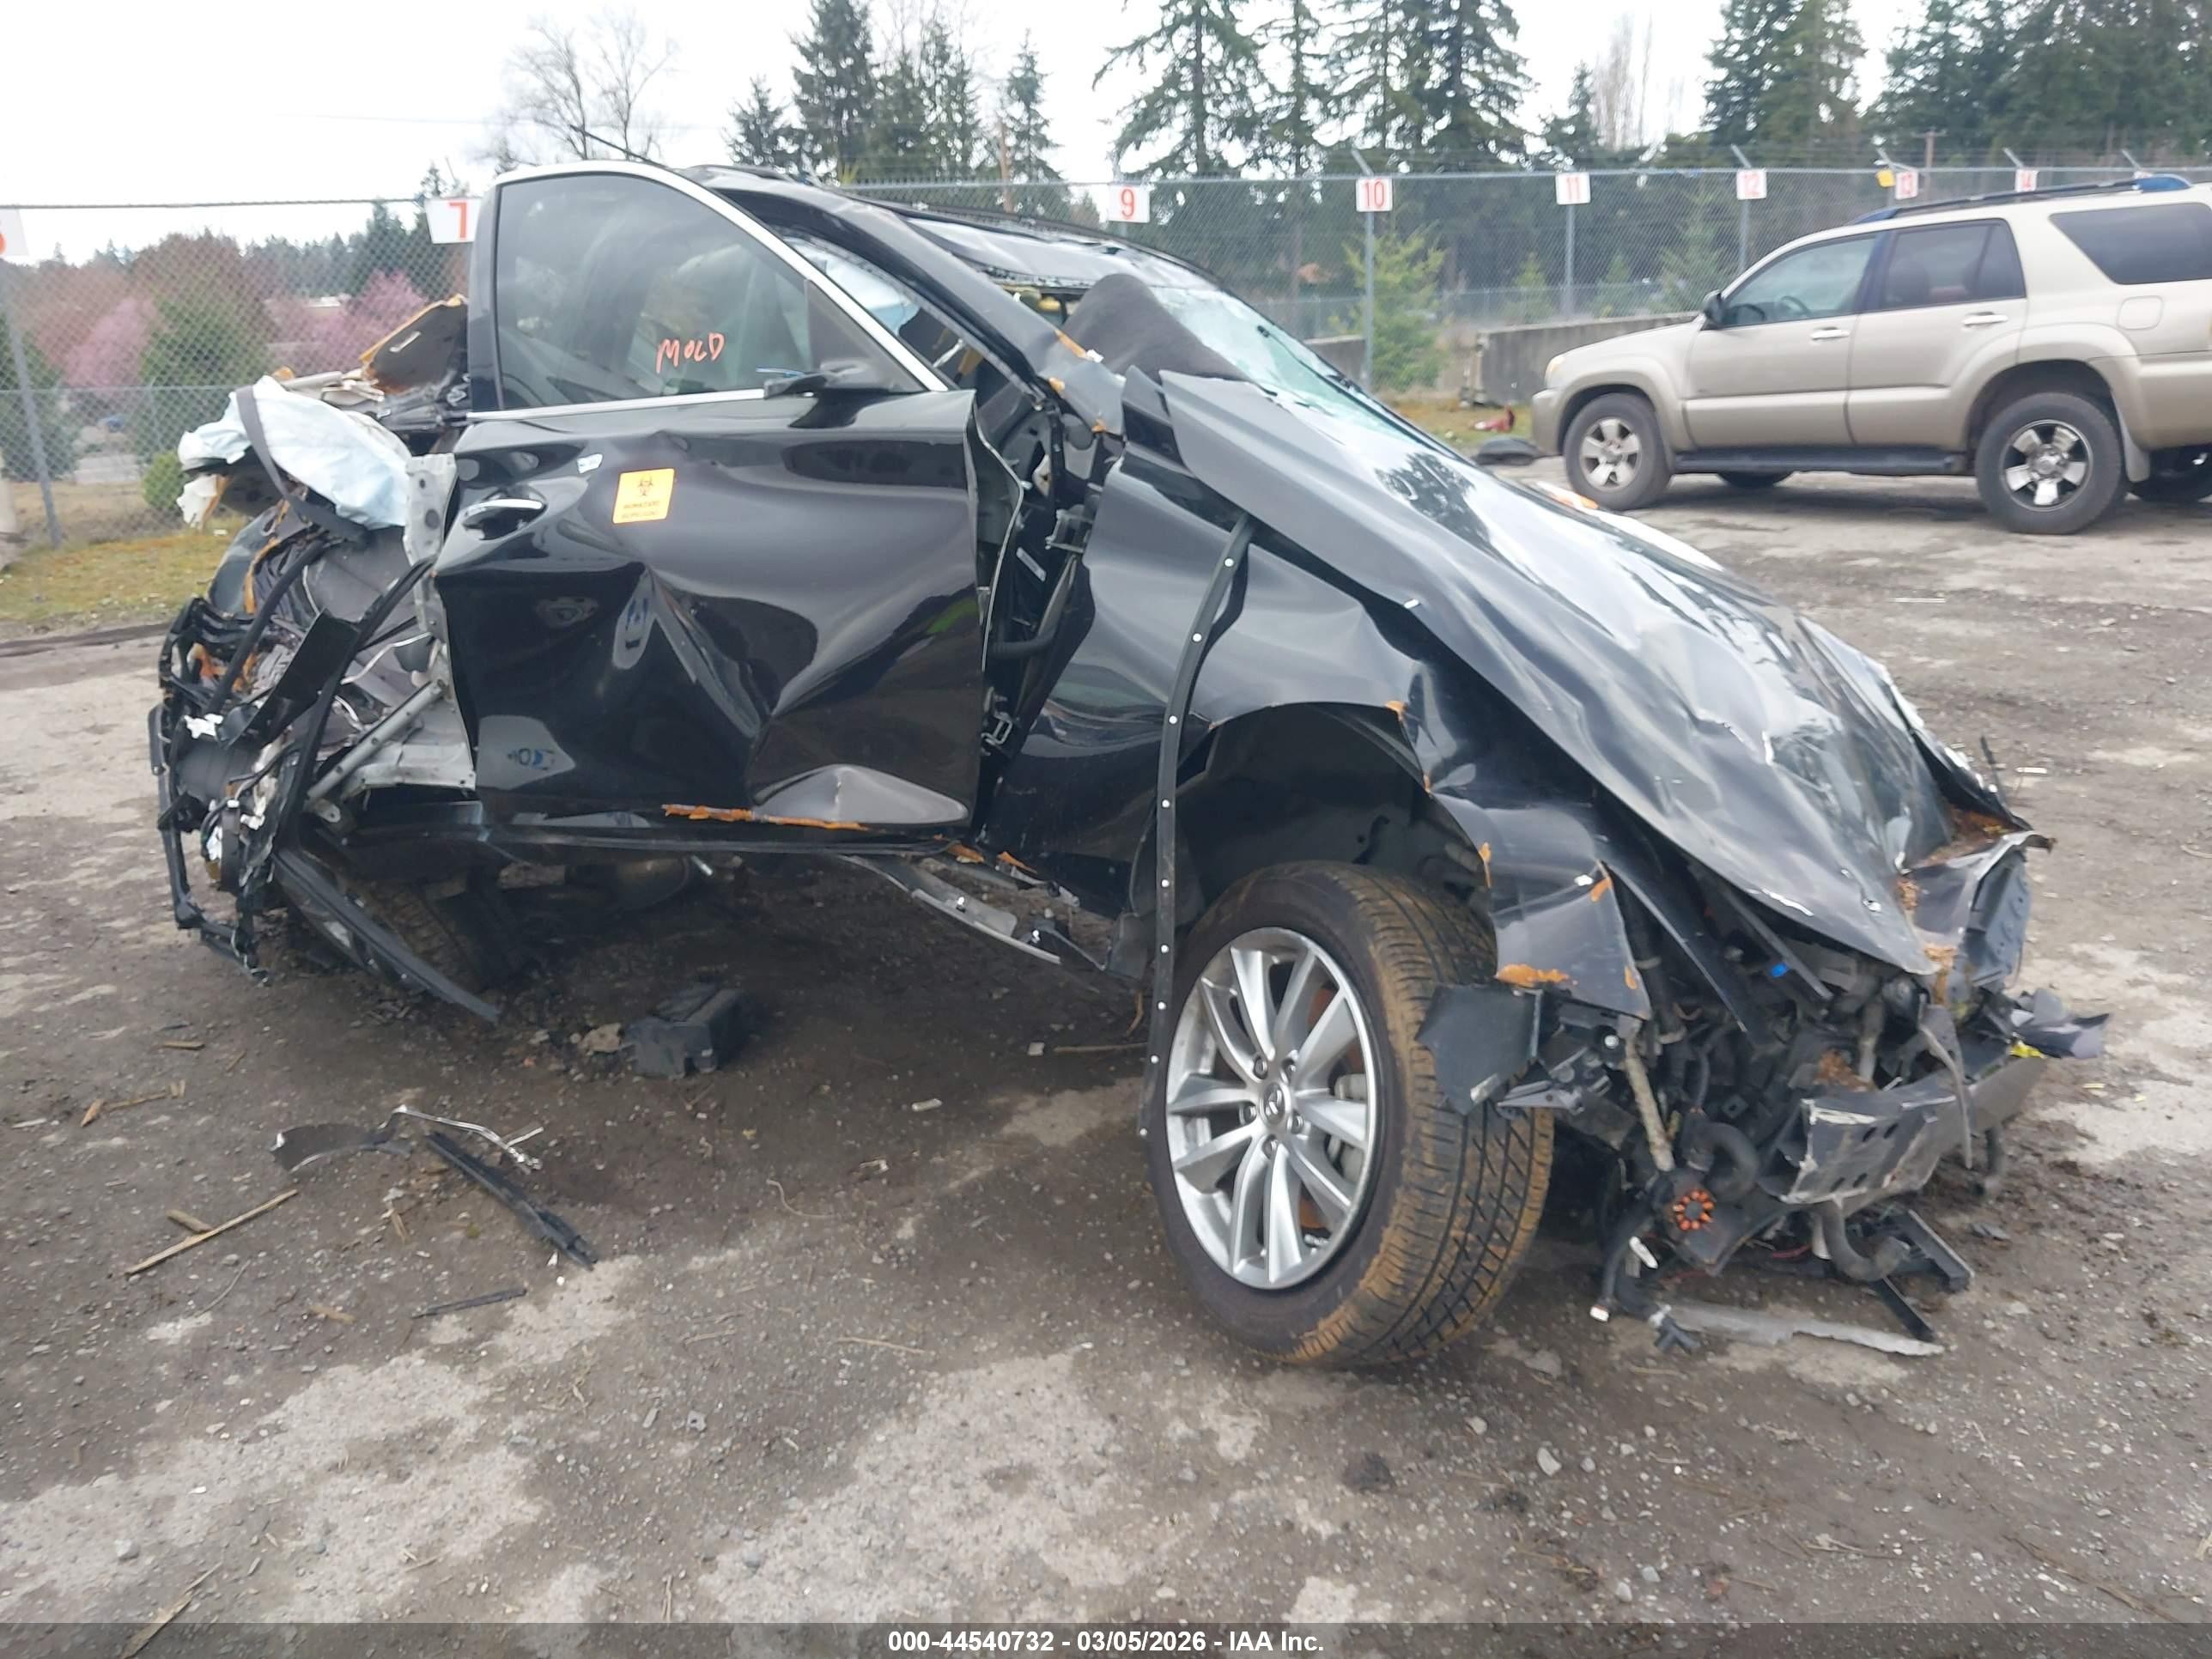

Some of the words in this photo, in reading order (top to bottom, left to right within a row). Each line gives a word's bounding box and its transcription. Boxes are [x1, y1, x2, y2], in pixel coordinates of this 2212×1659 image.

[1364, 180, 1385, 208] 10
[1566, 176, 1582, 204] 11
[1743, 173, 1760, 197] 12
[1120, 187, 1135, 219] 9
[448, 202, 467, 239] 7
